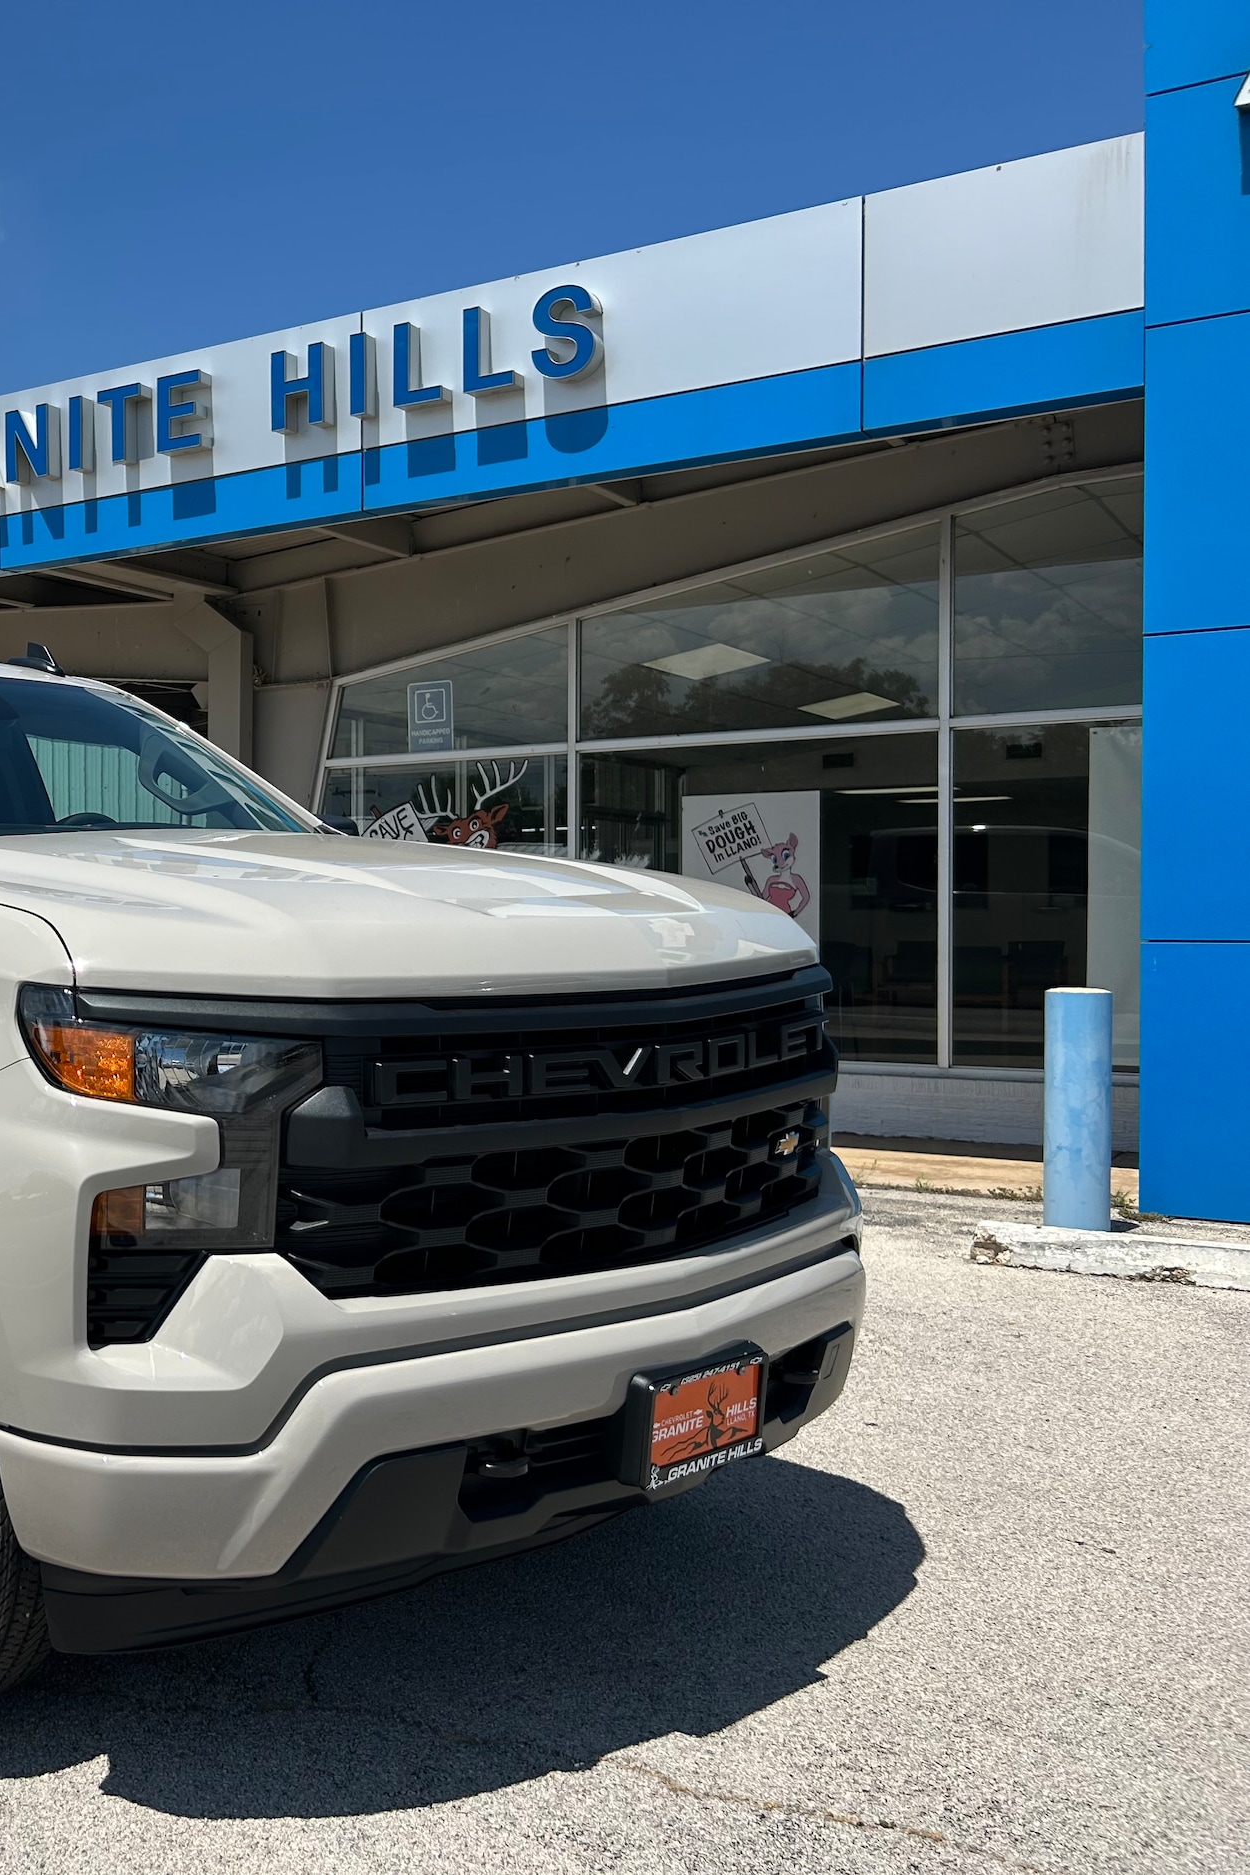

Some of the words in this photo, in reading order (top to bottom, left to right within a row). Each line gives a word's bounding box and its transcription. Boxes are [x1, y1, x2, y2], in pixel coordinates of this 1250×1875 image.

[271, 284, 603, 435] HILLS
[411, 728, 450, 737] HANDICAPPED
[418, 737, 444, 745] PARKING
[731, 811, 748, 825] BIG
[705, 820, 757, 854] DOUGH
[724, 834, 762, 857] LLANO!
[373, 1015, 829, 1106] CHEVROLET
[652, 1416, 704, 1443] GRANITE
[726, 1397, 757, 1418] HILLS
[660, 1410, 694, 1427] CHEVROLET
[748, 1410, 756, 1419] TX
[667, 1449, 725, 1481] GRANITE
[727, 1438, 763, 1461] HILLS
